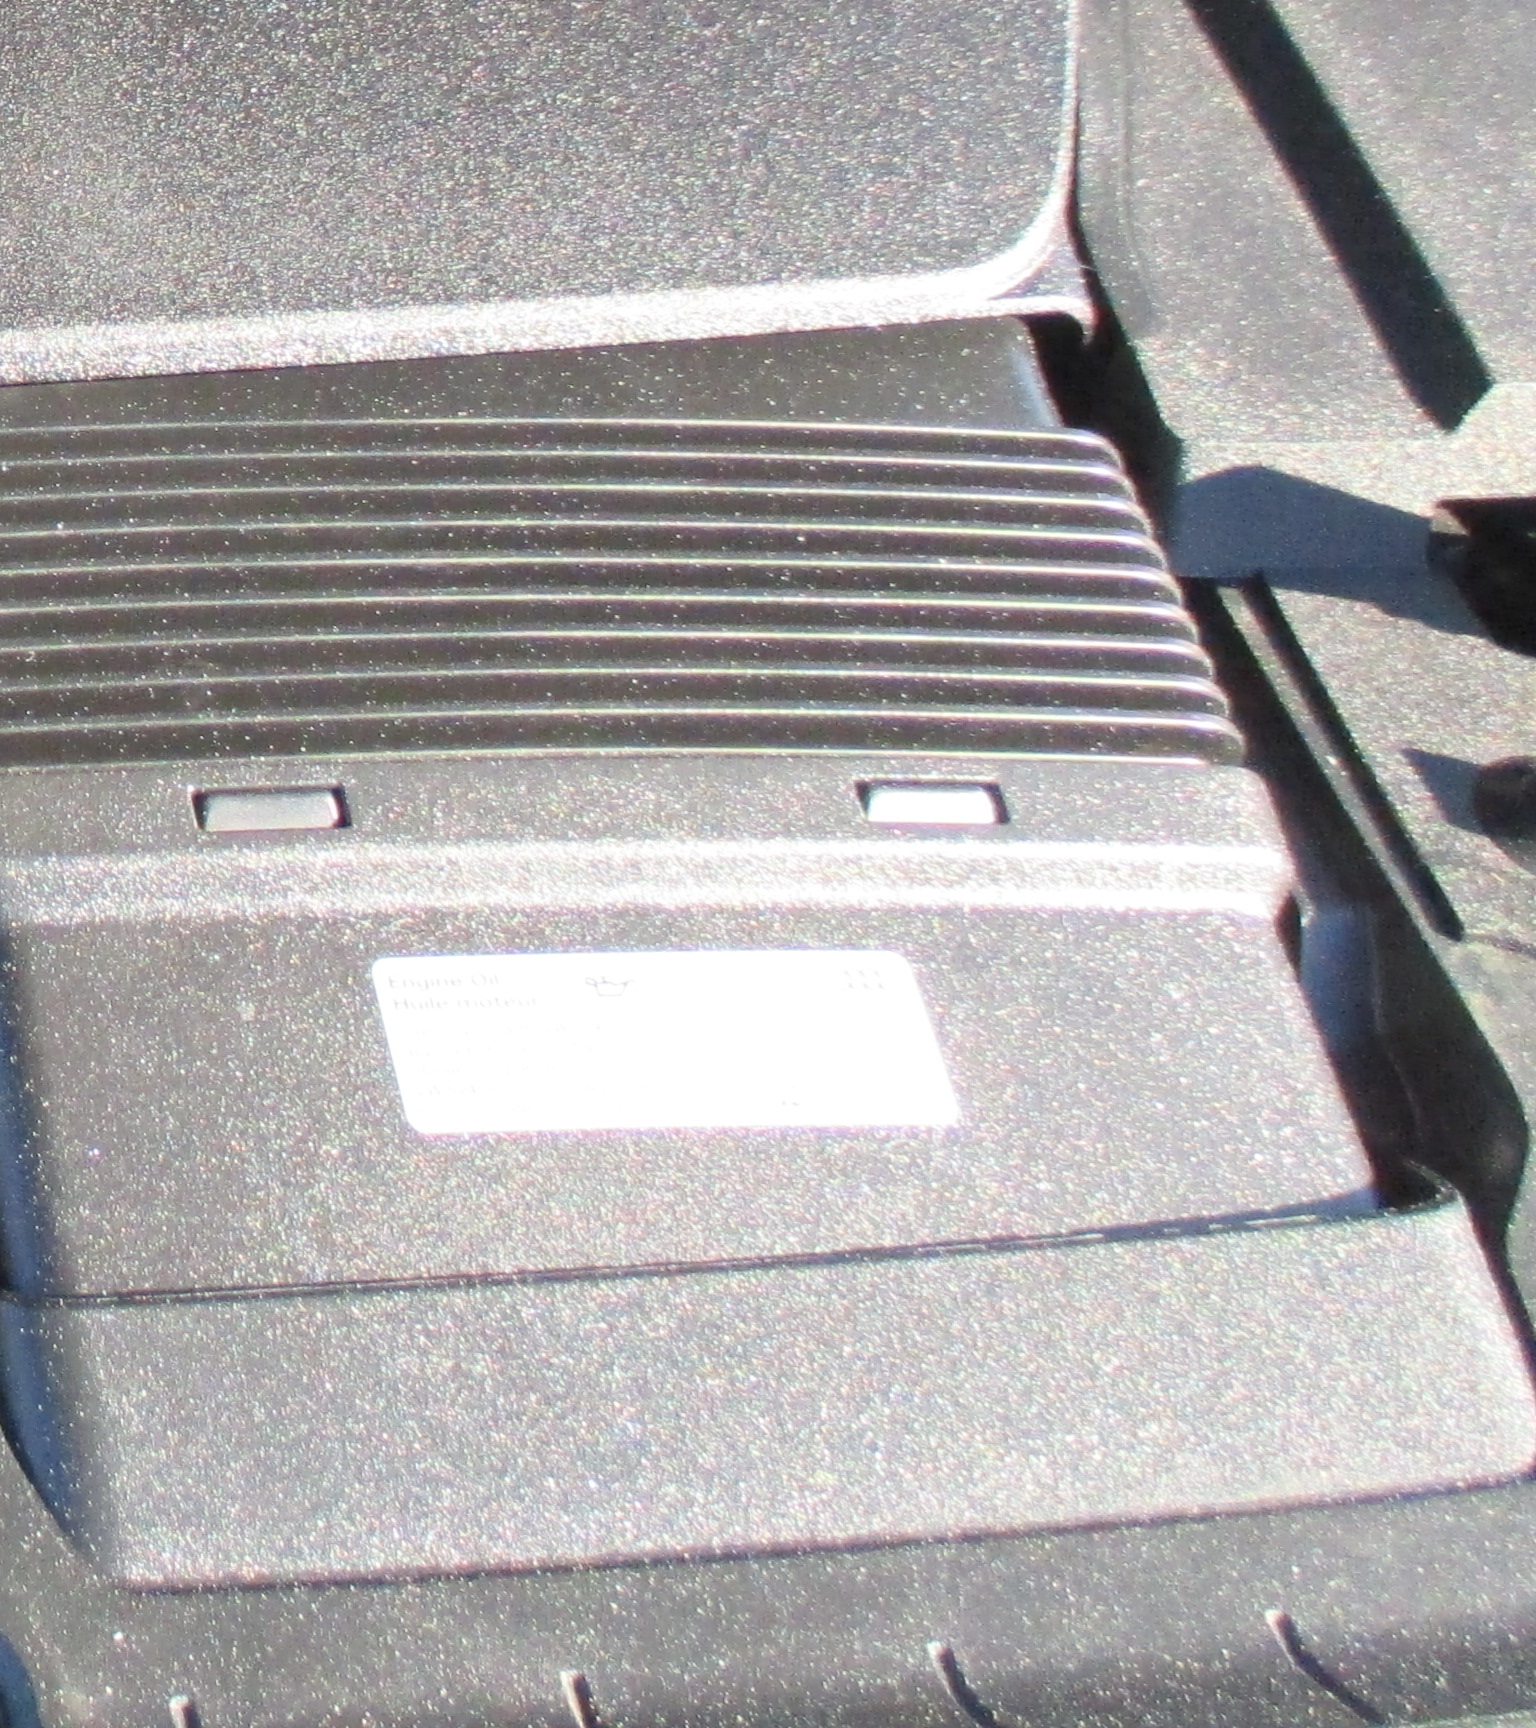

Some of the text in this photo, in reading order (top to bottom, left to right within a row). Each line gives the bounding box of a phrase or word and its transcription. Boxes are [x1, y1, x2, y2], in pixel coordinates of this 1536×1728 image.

[387, 973, 500, 992] Engine Oil
[393, 996, 448, 1010] Huile
